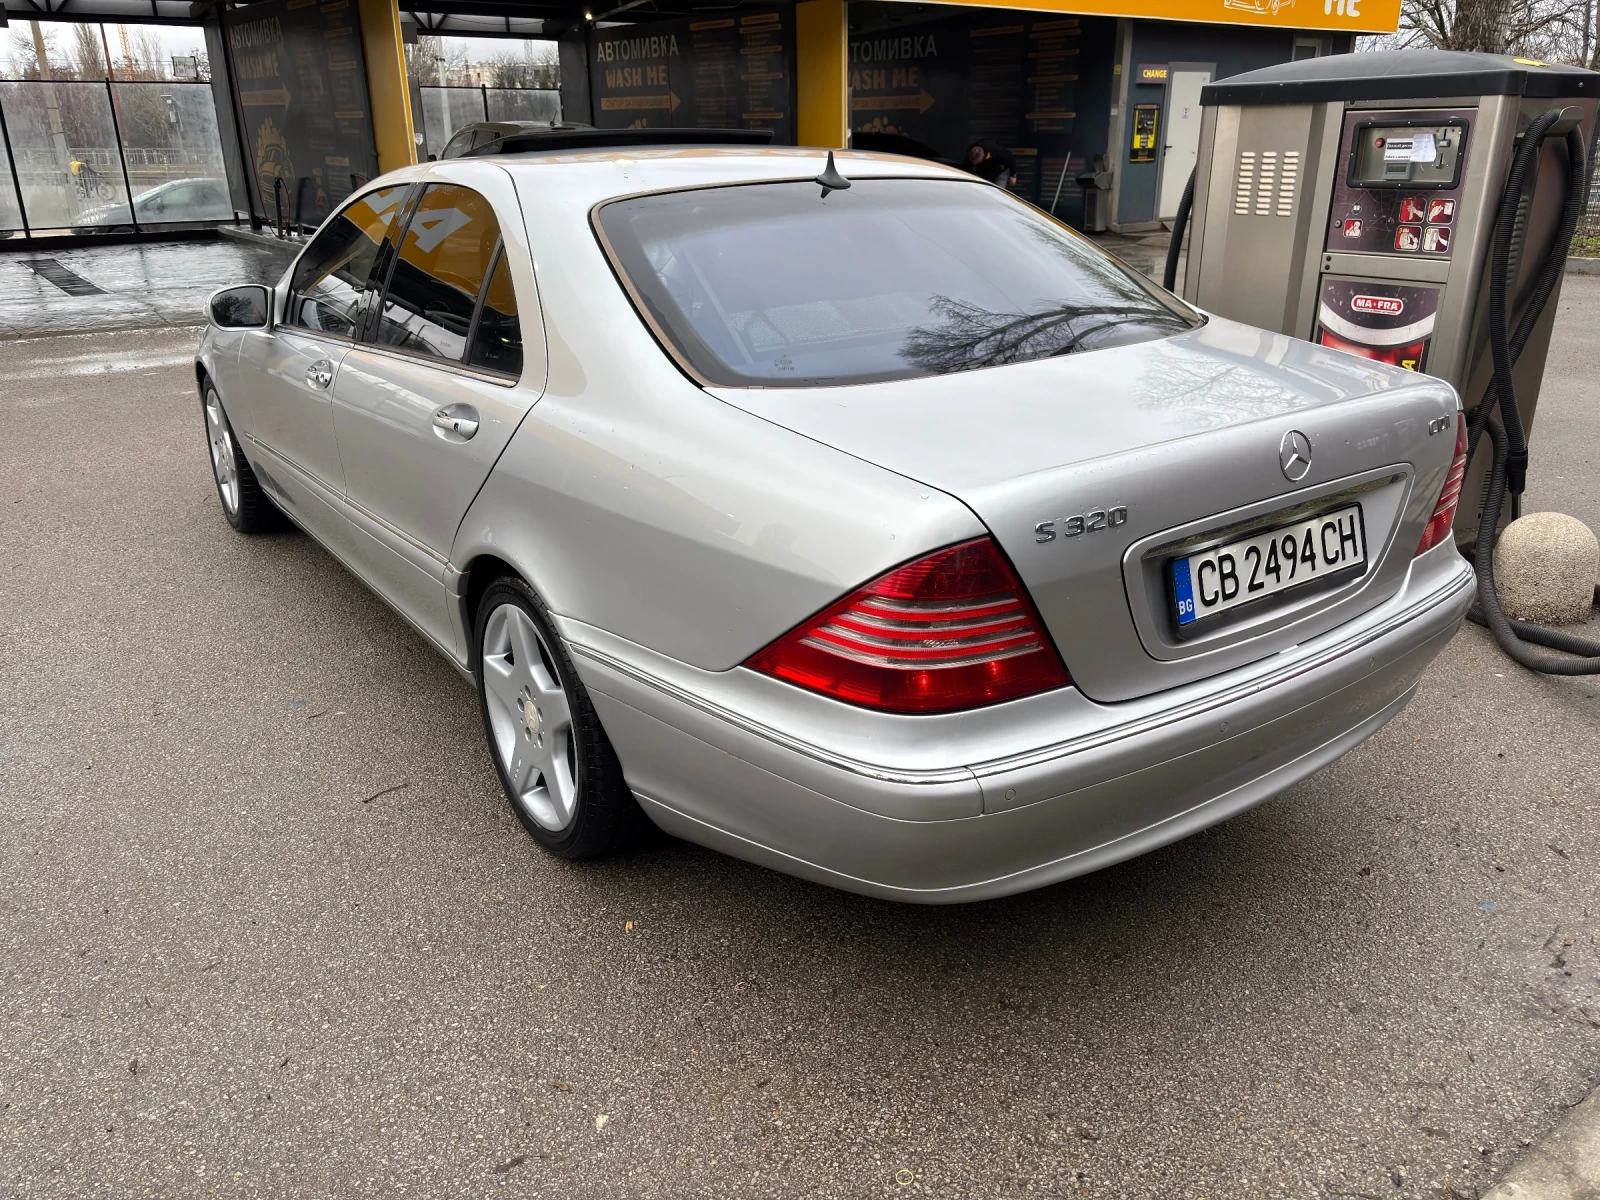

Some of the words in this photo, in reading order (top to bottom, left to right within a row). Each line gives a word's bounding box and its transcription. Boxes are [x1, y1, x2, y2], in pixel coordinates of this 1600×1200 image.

[229, 16, 283, 49] АВТОМИВКА
[597, 34, 679, 62] АВТОМИВКА
[850, 34, 938, 63] ТОМИВКА
[265, 52, 280, 77] ME
[605, 67, 642, 89] WASH
[646, 65, 667, 86] ME
[1142, 69, 1167, 79] CHANGE
[849, 69, 886, 90] ASH
[892, 66, 919, 88] ME
[1035, 520, 1056, 543] S
[1064, 505, 1128, 537] 320
[1197, 553, 1240, 607] CB
[1244, 527, 1317, 593] 2494
[1320, 514, 1358, 565] CH
[1178, 598, 1193, 615] BG
